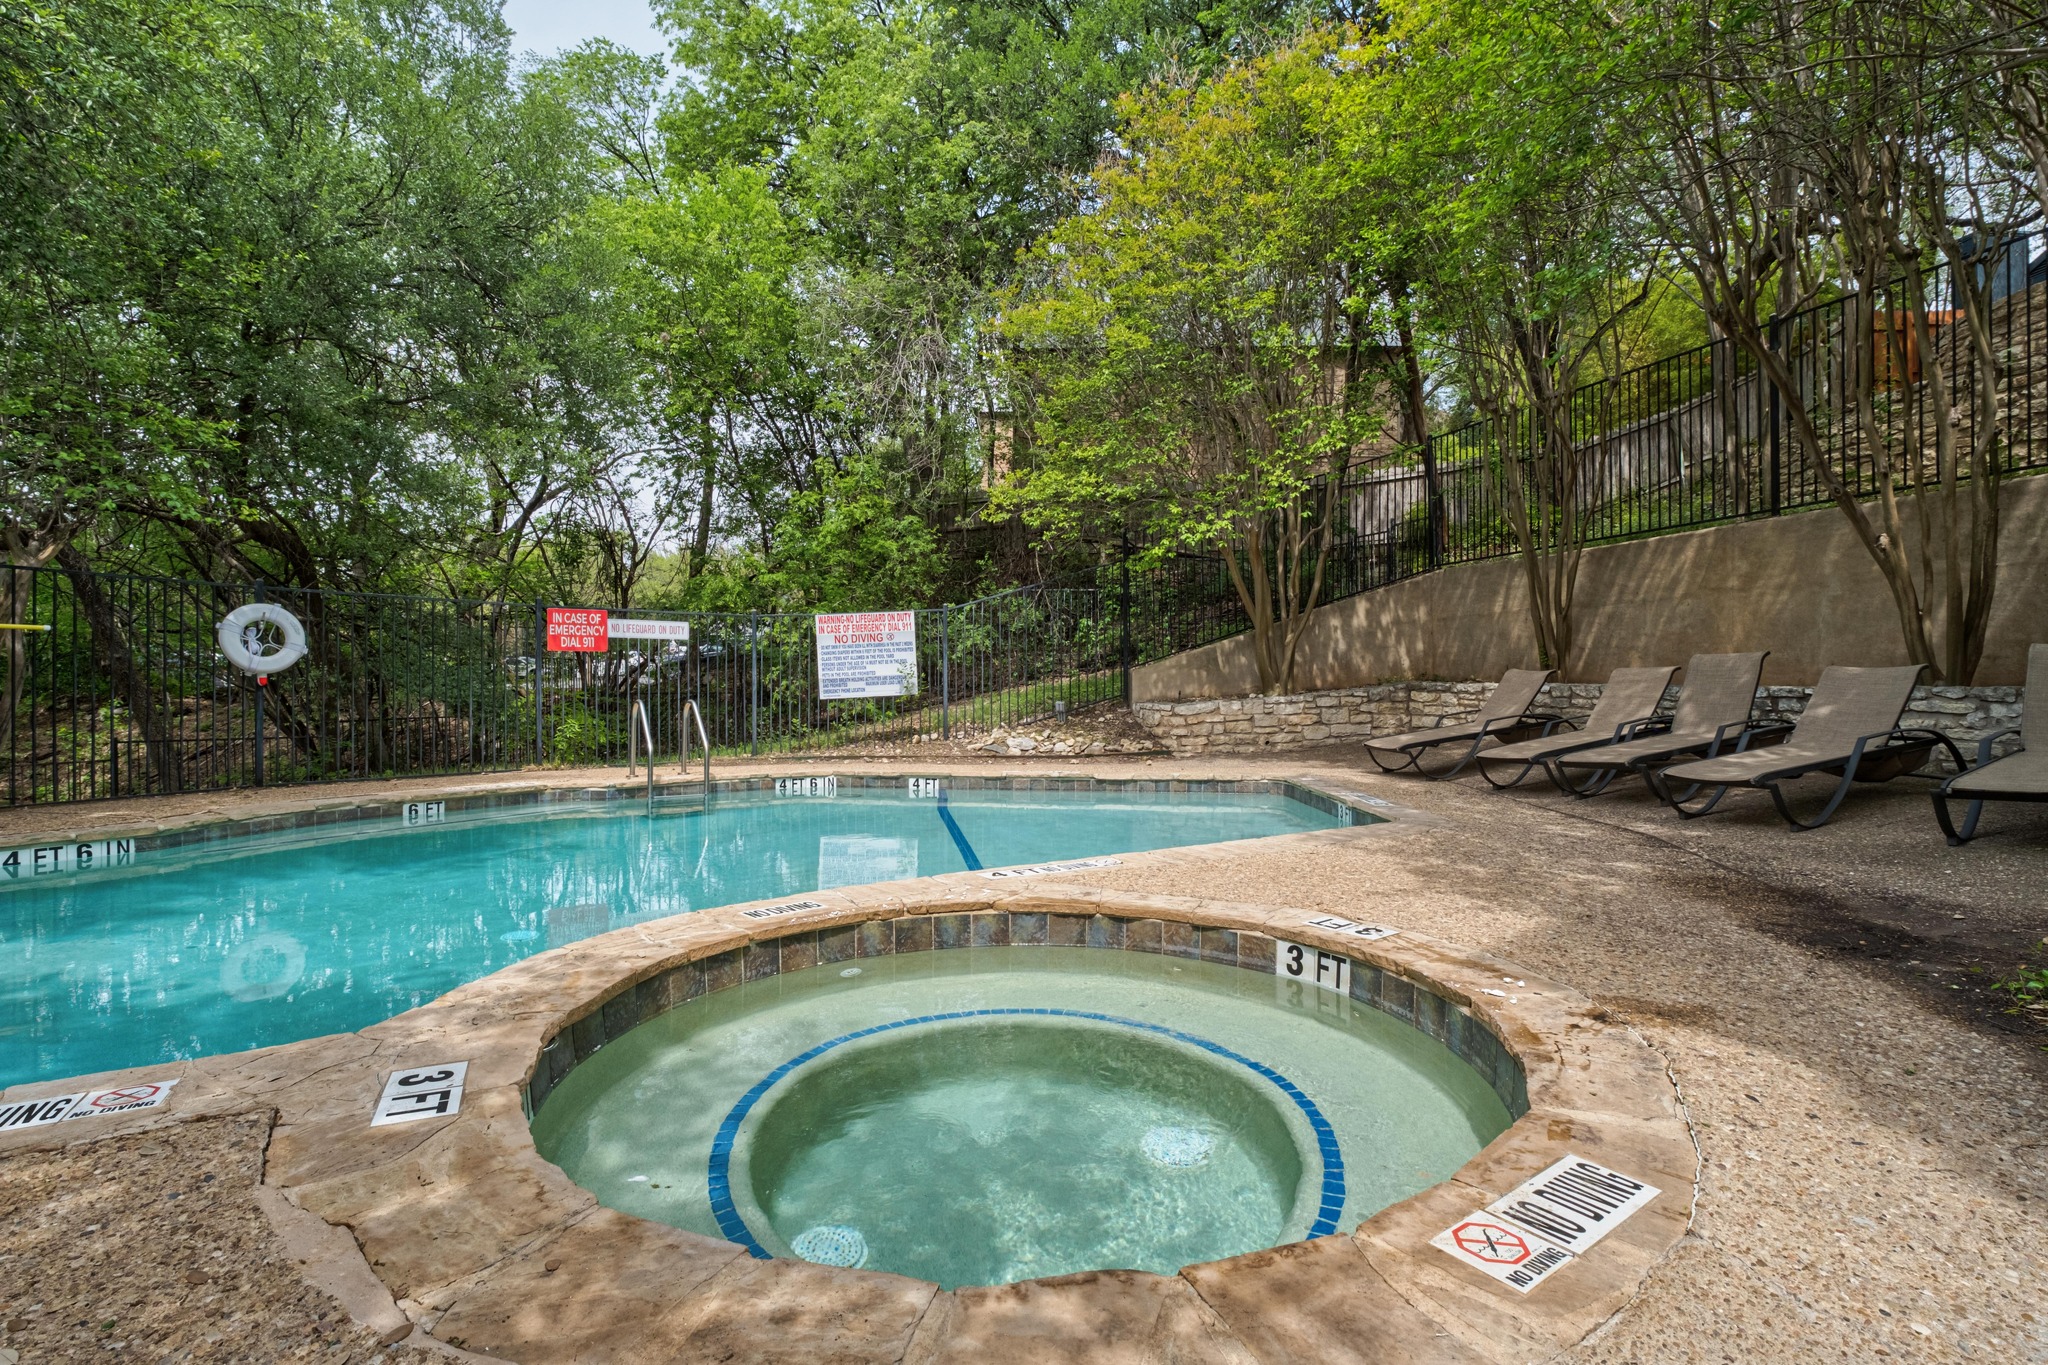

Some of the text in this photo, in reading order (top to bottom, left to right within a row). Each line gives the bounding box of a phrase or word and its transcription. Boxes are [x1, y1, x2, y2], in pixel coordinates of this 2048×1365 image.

[553, 613, 601, 624] IN CASE OF
[818, 613, 911, 624] WARNING-NO LIFEGUARD ON DUTY
[550, 624, 605, 636] EMERGENCY
[611, 624, 685, 635] NO LIFEGUARD ON DUTY
[826, 625, 841, 633] CASE
[843, 624, 850, 633] OF
[852, 623, 886, 632] EMERGENCY
[888, 623, 900, 631] DIAL
[902, 622, 912, 630] 911
[560, 637, 594, 647] DIAL 911
[835, 633, 883, 644] NO DIVING
[779, 777, 834, 789] 4 FT 6 IN
[912, 778, 937, 789] 4 FT
[409, 802, 442, 814] 6 FT
[1340, 805, 1343, 818] 3
[2, 839, 130, 866] 4 FT 6 IN
[743, 902, 822, 918] NO DIVING
[1308, 919, 1384, 936] 3 FT
[1286, 945, 1346, 989] 3 FT
[386, 1070, 454, 1117] 3 FT
[100, 1100, 156, 1112] DIVING
[1502, 1162, 1644, 1244] NO DIVING
[1505, 1270, 1533, 1288] NO
[1528, 1247, 1567, 1276] DIVING
